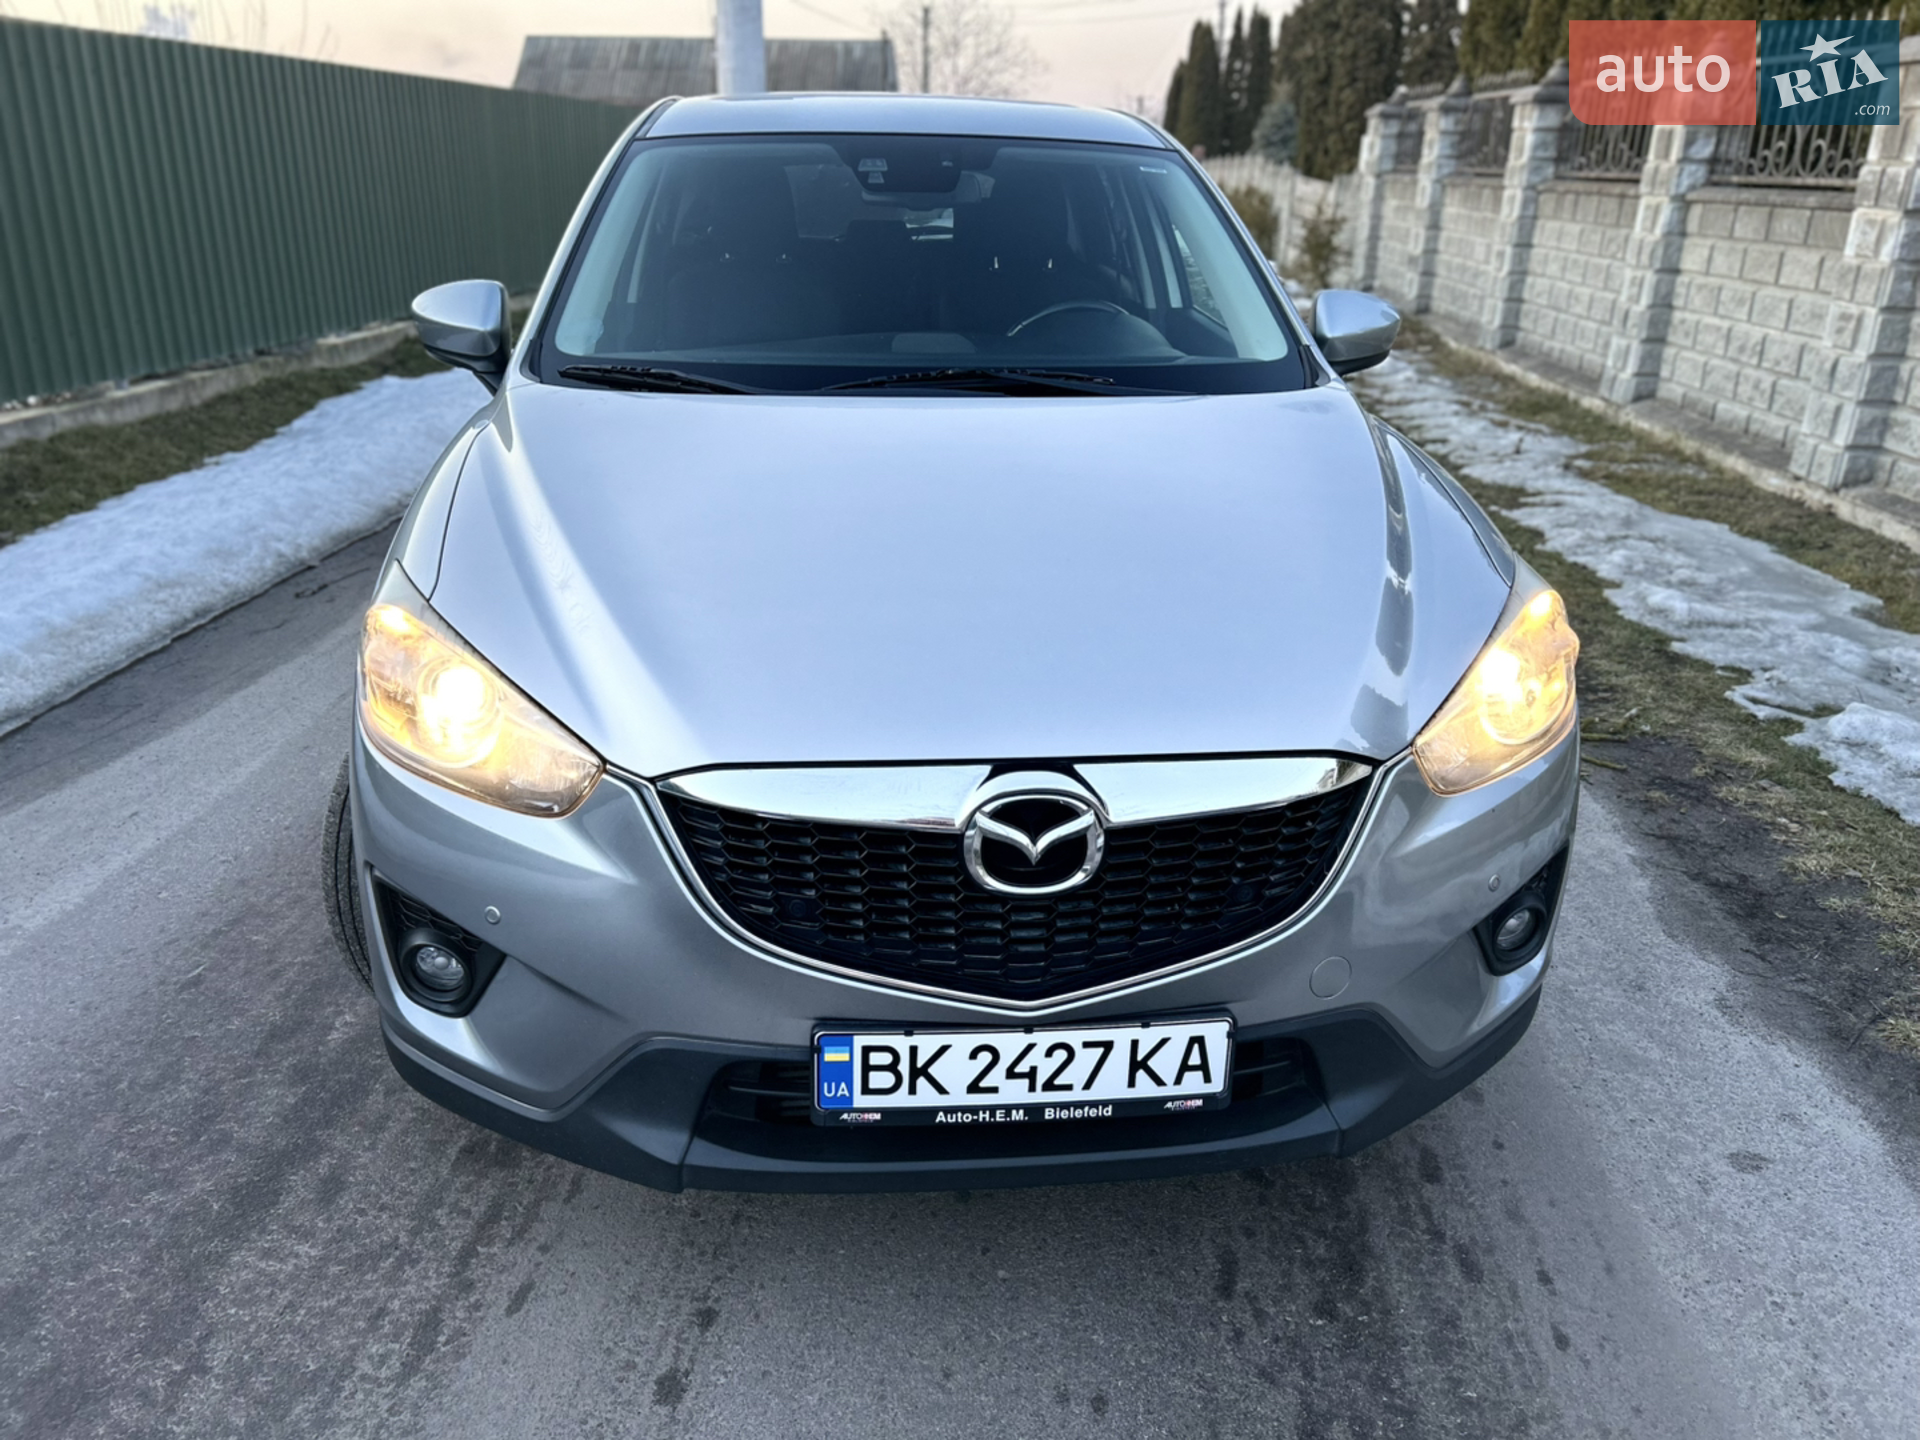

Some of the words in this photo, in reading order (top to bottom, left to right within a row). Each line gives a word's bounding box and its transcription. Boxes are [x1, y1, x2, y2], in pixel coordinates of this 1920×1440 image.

[861, 1044, 952, 1096] BK
[966, 1041, 1114, 1095] 2427
[1127, 1035, 1212, 1088] KA
[824, 1082, 849, 1097] UA
[935, 1109, 1028, 1123] Auto-H.E.M.
[1044, 1105, 1112, 1120] Bielefeld
